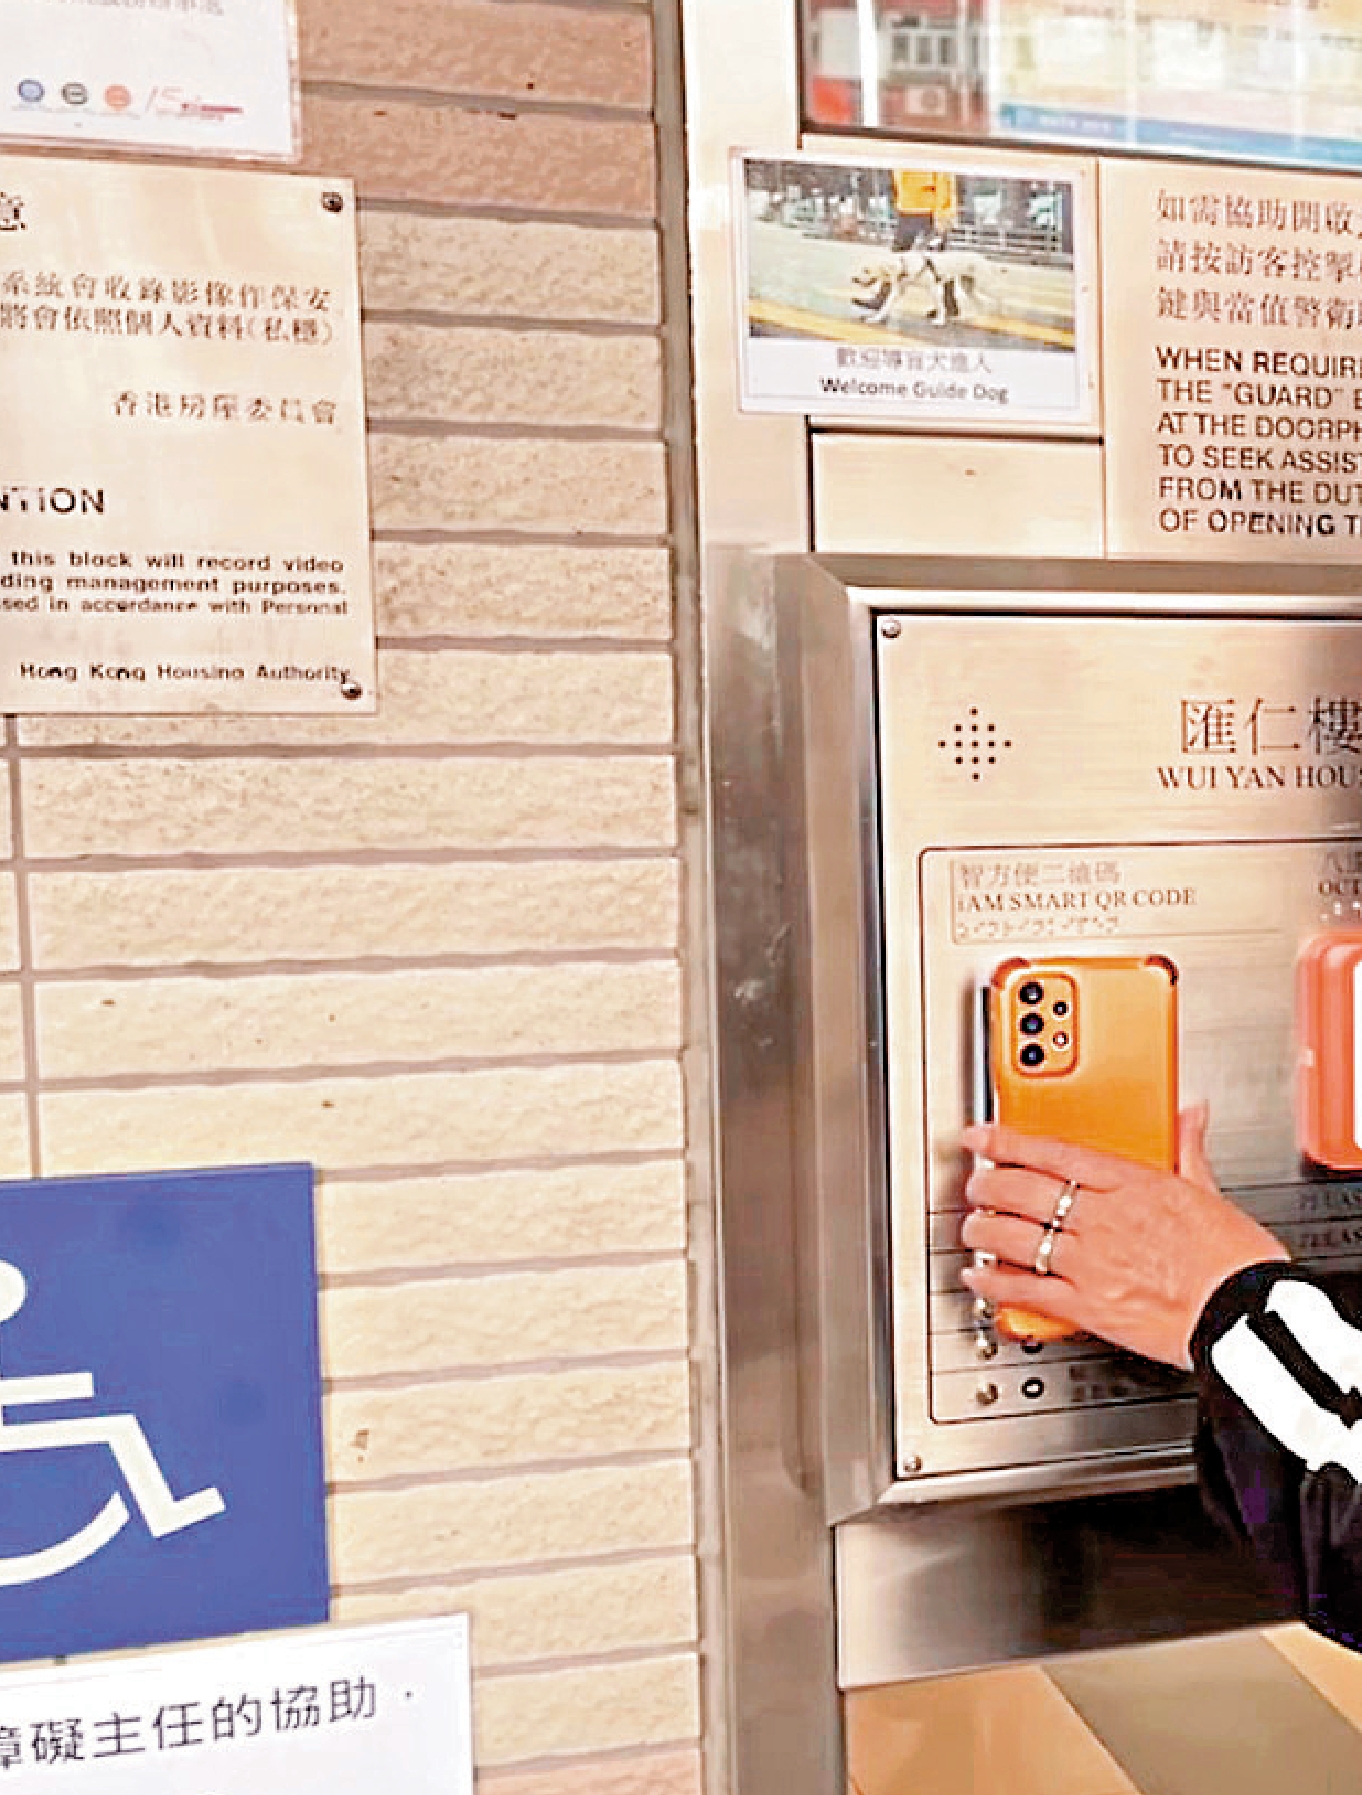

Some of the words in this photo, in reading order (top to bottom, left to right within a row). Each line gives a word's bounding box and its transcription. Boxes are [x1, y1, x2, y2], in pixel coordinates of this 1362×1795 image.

[1156, 346, 1243, 372] WHEN
[818, 375, 908, 397] Welcome
[913, 380, 969, 400] Guide
[973, 383, 1009, 405] Dog
[1156, 378, 1213, 404] THE
[1222, 381, 1344, 409] "GUARD"
[1157, 412, 1188, 434] AT
[1193, 412, 1247, 437] THE
[1158, 443, 1195, 468] TO
[1202, 445, 1275, 470] SEEK
[1158, 476, 1243, 501] FROM
[1251, 478, 1304, 504] THE
[1158, 508, 1198, 532] OF
[1207, 509, 1335, 537] OPENING
[11, 550, 56, 567] this
[69, 550, 133, 568] block
[145, 553, 185, 569] will
[196, 555, 271, 571] record
[282, 555, 345, 573] video
[66, 575, 220, 595] management
[50, 596, 69, 612] in
[81, 598, 198, 614] accordance
[207, 598, 251, 615] with
[20, 661, 77, 683] Hong
[89, 661, 146, 683] Kong
[157, 662, 245, 684] Housing
[1156, 765, 1218, 790] WUI
[1225, 765, 1286, 790] YAN
[1008, 890, 1088, 911] SMART
[1094, 888, 1128, 911] QR
[1132, 885, 1199, 907] CODE
